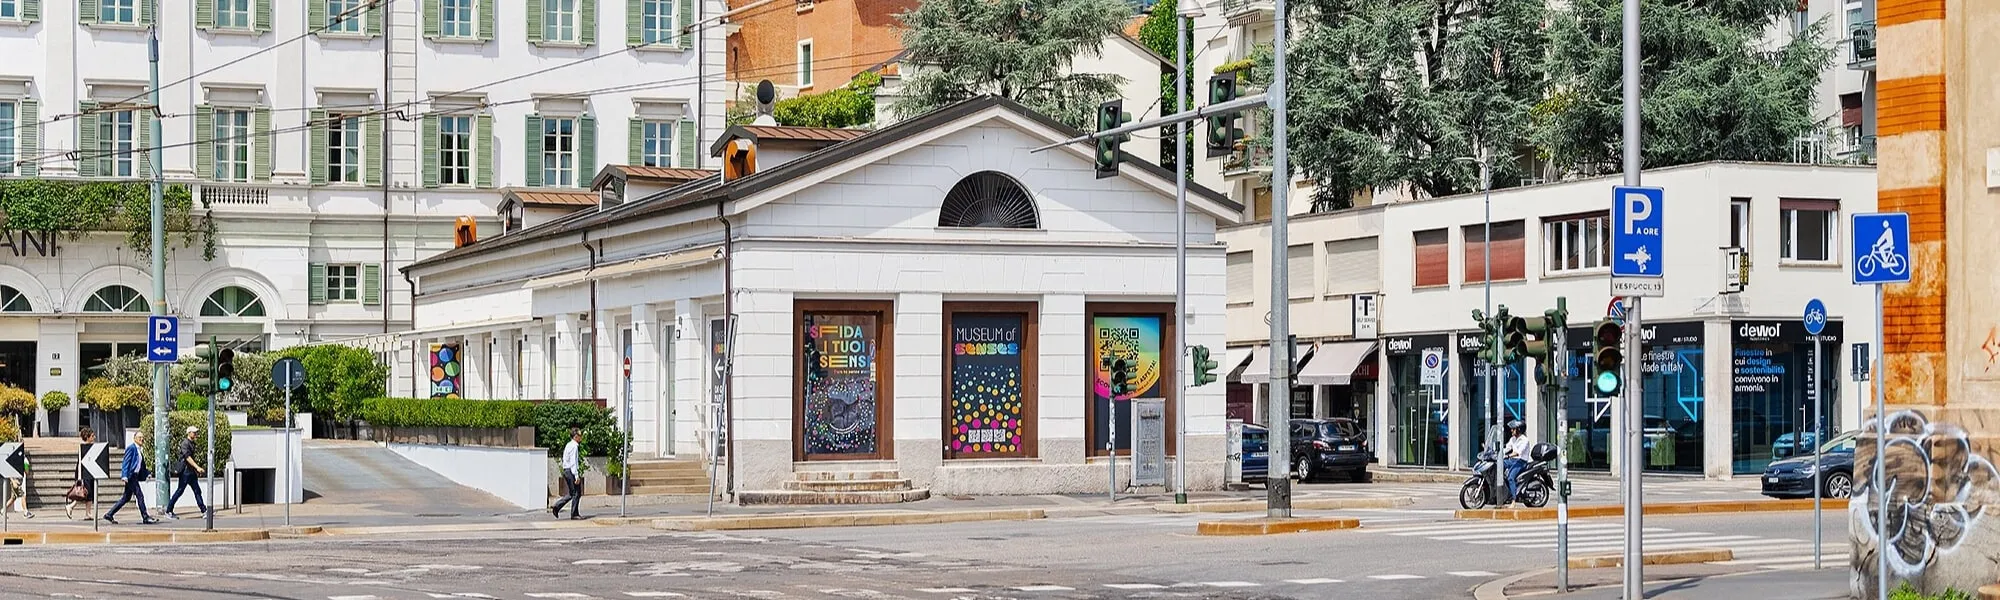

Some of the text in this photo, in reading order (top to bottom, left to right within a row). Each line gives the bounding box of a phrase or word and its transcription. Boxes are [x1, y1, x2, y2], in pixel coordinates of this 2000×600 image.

[1624, 193, 1652, 235] P
[1643, 227, 1659, 236] ORE
[1729, 252, 1738, 270] T
[1359, 296, 1373, 316] T
[155, 319, 172, 341] P
[810, 324, 863, 339] SFIDA
[956, 327, 1017, 341] MUSEUM of
[831, 340, 866, 353] TUOI
[1766, 348, 1773, 356] in
[819, 355, 871, 369] SENSI
[1735, 357, 1771, 367] cui design
[1772, 375, 1778, 383] in
